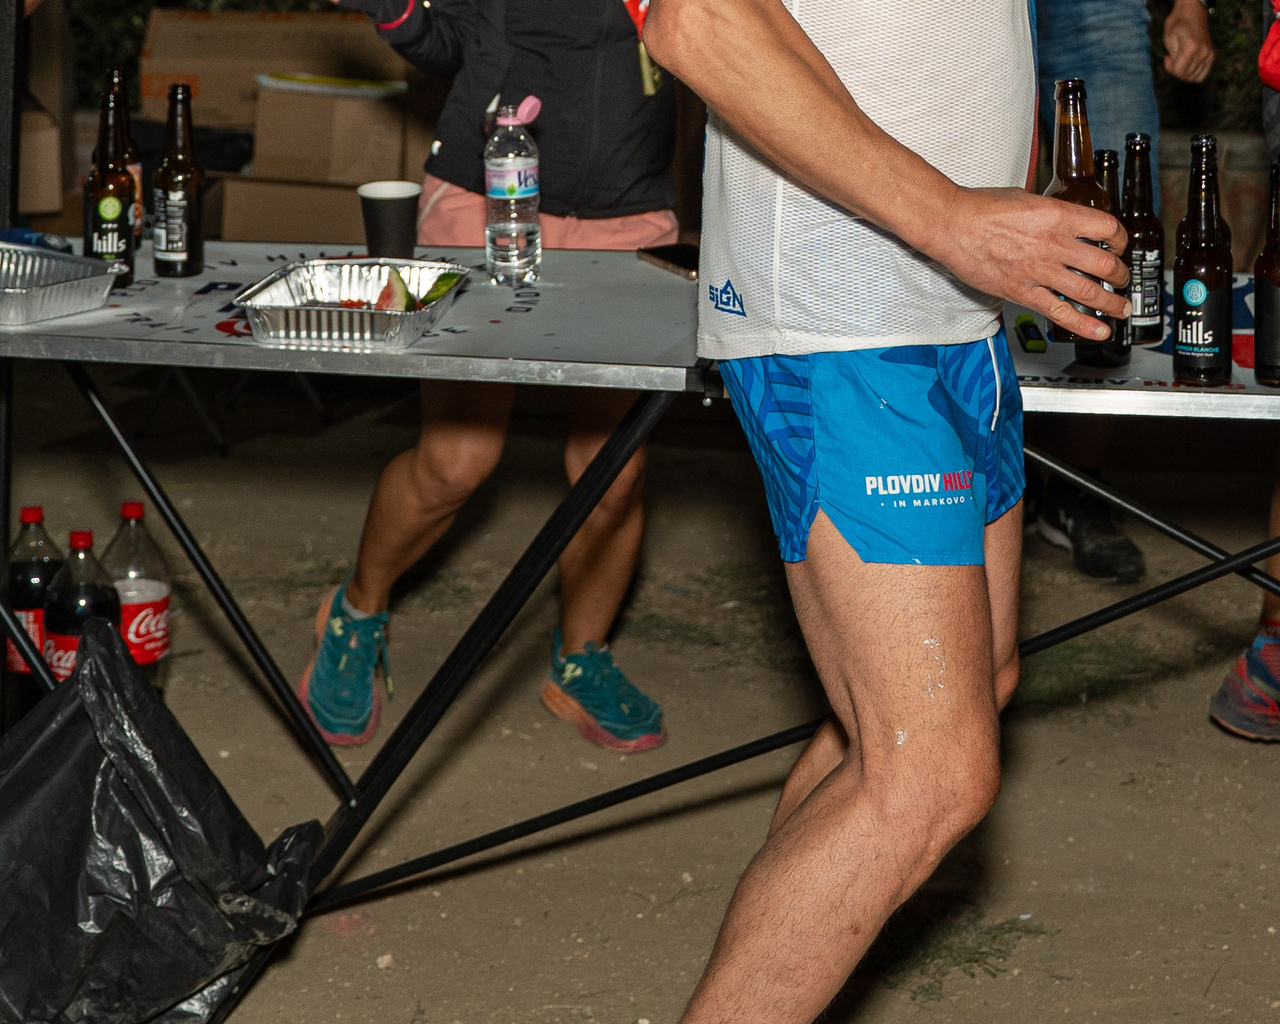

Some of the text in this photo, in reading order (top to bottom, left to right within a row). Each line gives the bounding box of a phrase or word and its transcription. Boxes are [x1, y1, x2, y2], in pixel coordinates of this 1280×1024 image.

[92, 231, 127, 254] hills
[708, 278, 748, 318] SIGN
[1178, 320, 1213, 344] hills
[865, 470, 973, 496] PLOVDIV HILLS
[893, 495, 966, 508] IN MARKOVO
